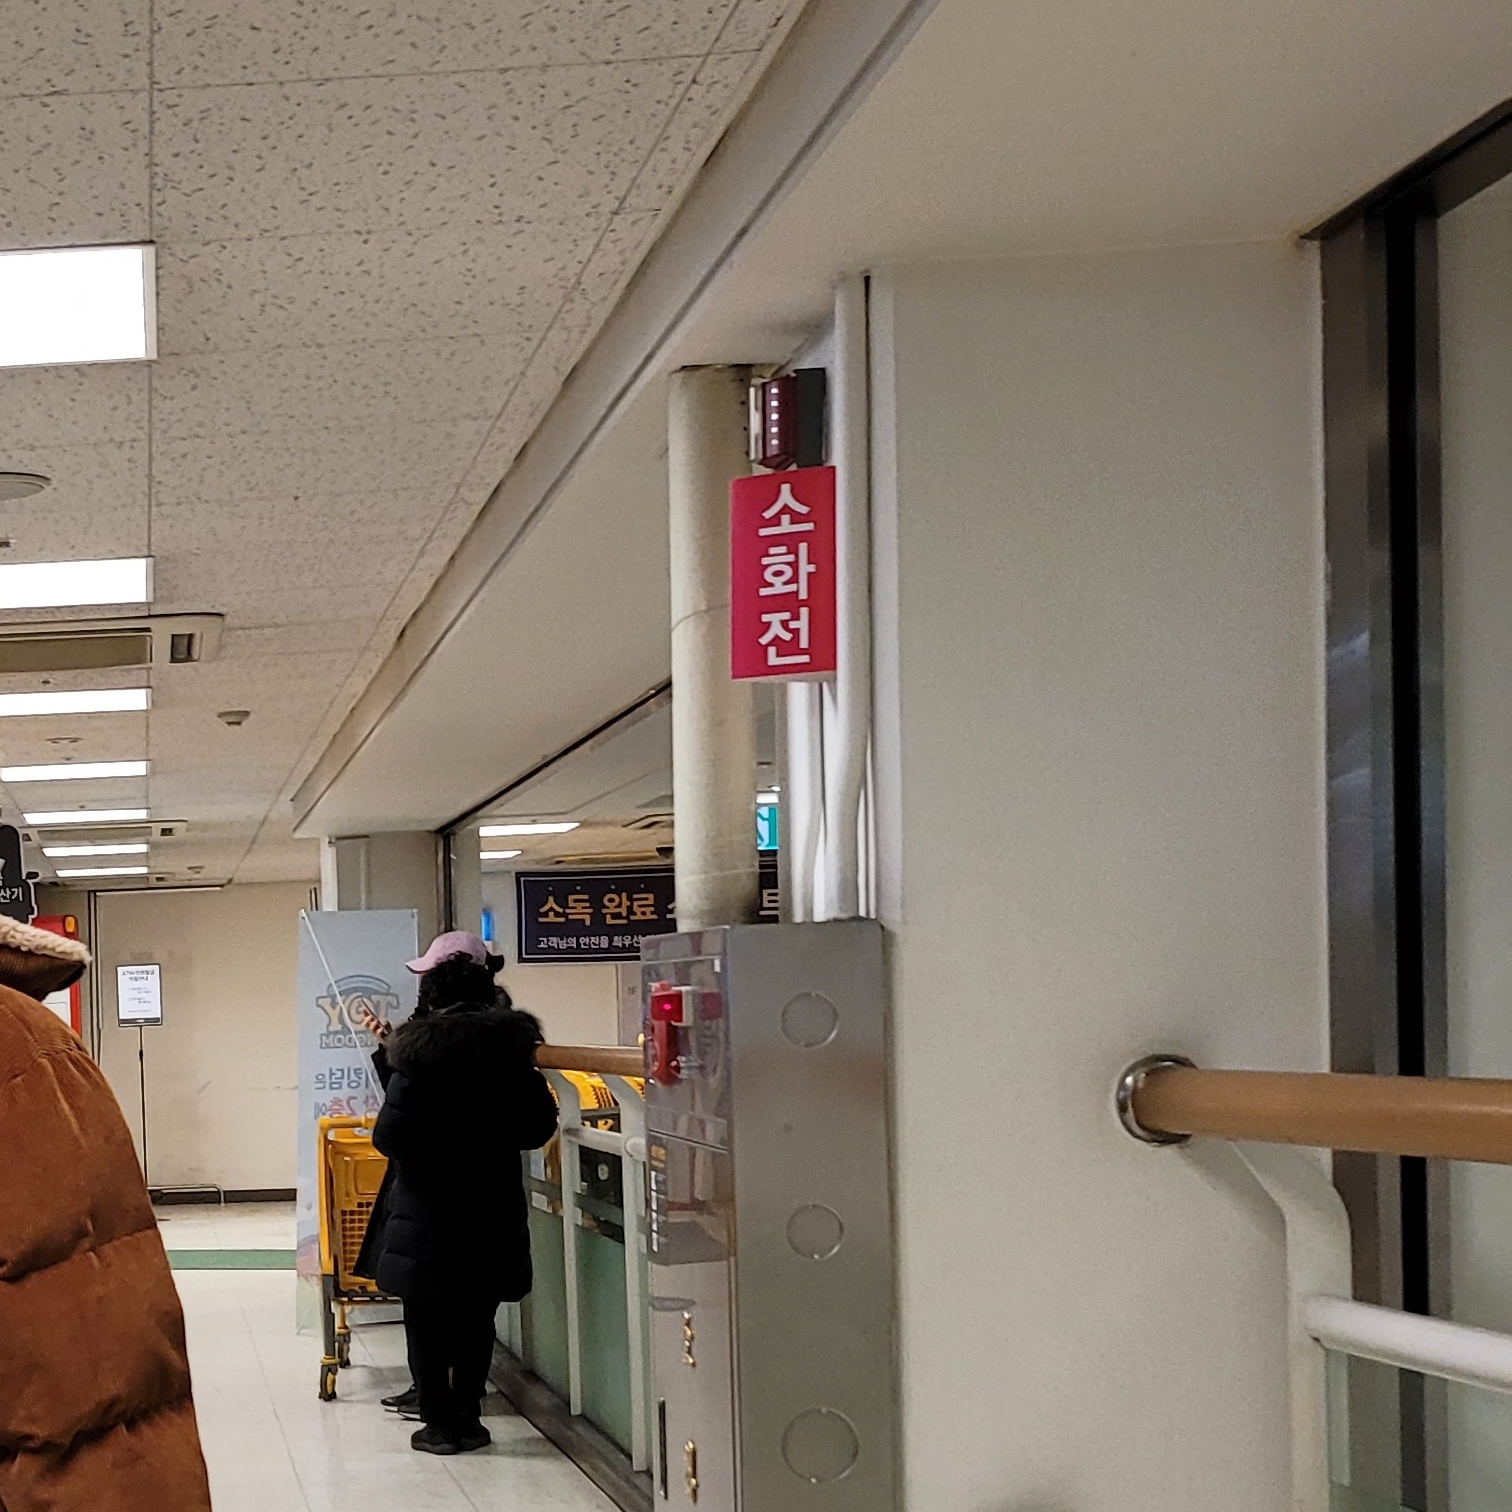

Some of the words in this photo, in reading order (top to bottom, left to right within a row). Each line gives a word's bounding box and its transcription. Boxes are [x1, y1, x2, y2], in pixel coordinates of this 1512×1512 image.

[757, 482, 817, 666] 소화전
[538, 893, 593, 926] 소독
[600, 891, 659, 925] 완료
